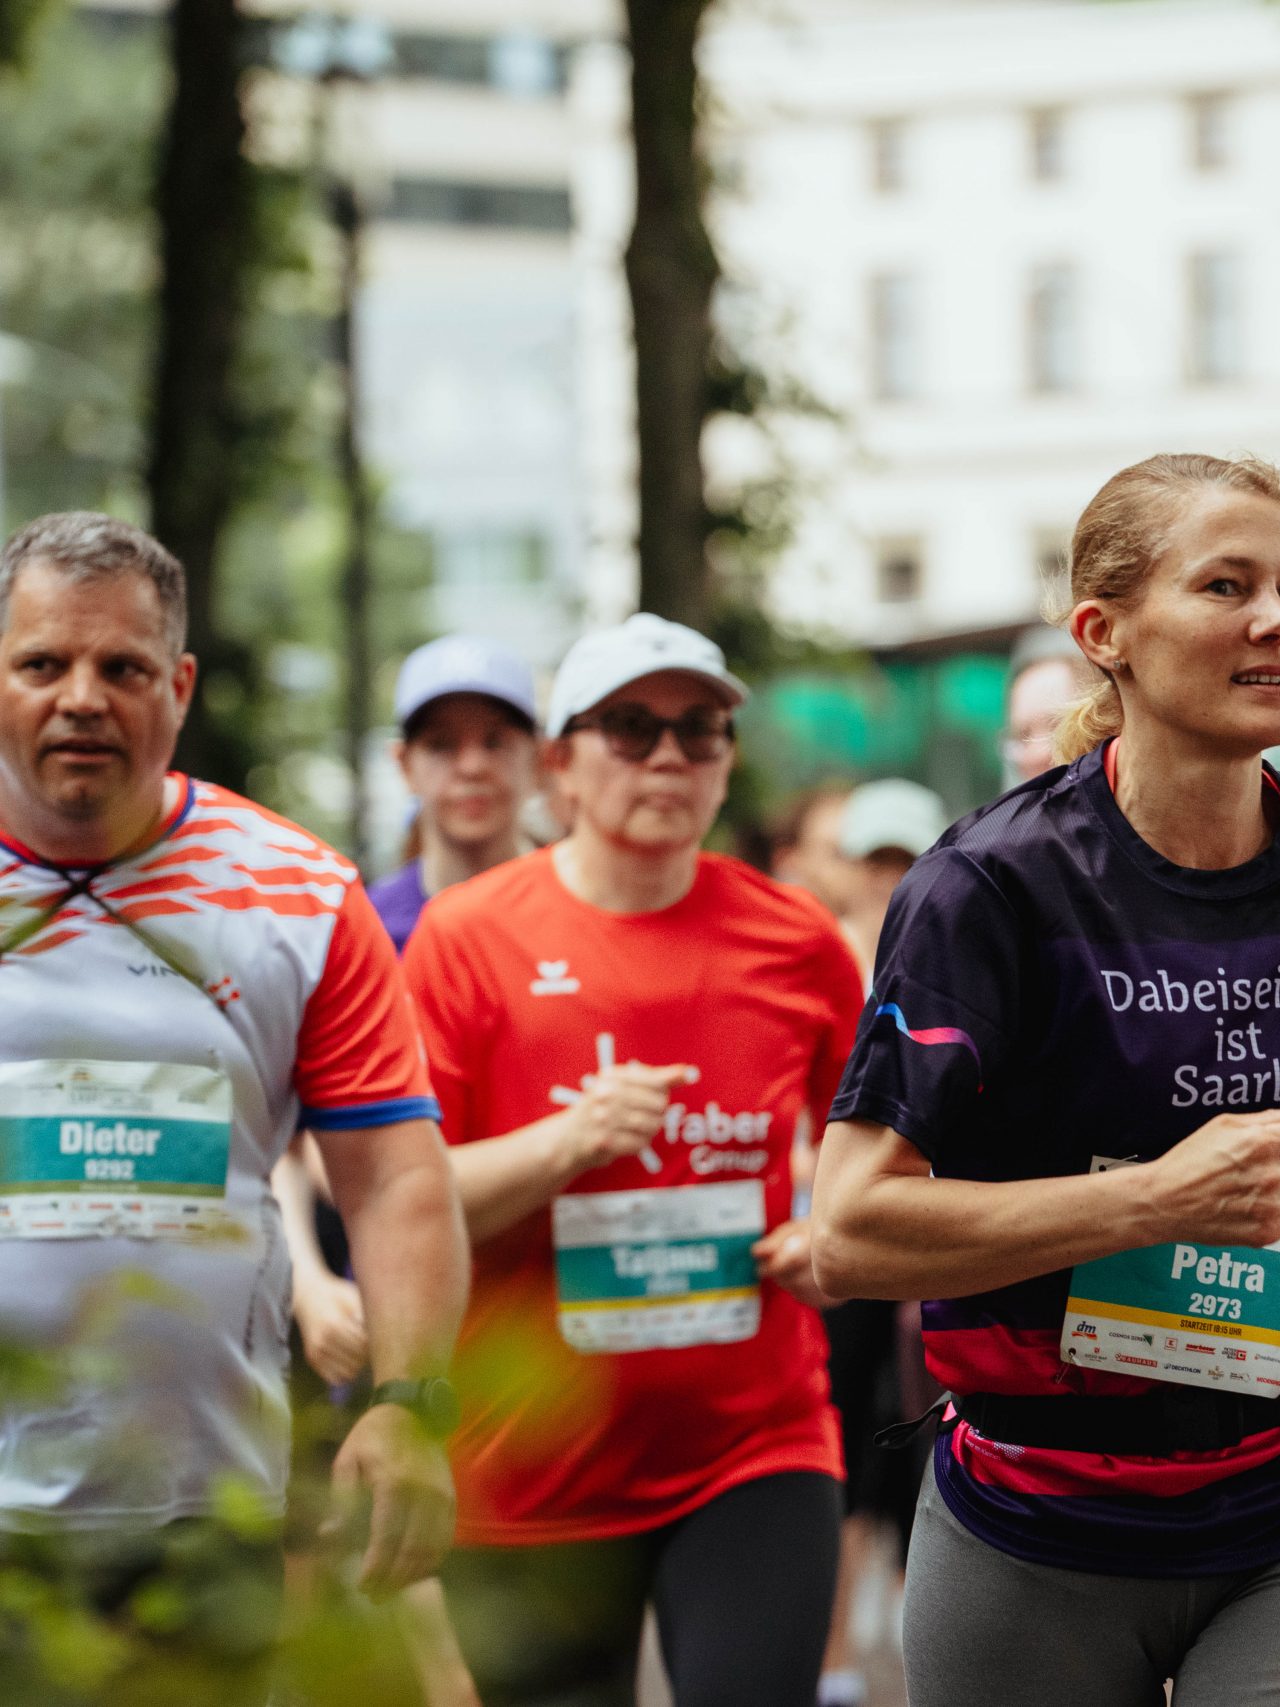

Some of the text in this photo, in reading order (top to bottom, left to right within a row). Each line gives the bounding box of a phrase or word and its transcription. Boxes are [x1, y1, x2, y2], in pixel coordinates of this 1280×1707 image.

[1214, 1016, 1268, 1062] ist
[664, 1101, 773, 1145] faber
[60, 1120, 161, 1156] Dieter
[1171, 1244, 1265, 1293] Petra
[1188, 1292, 1242, 1319] 2973
[1076, 1321, 1097, 1334] dm
[1180, 1319, 1213, 1332] STARTZEIT
[1228, 1327, 1242, 1336] UHR
[1120, 1355, 1158, 1368] BAUHAUS
[1171, 1365, 1202, 1374] DECATHLON
